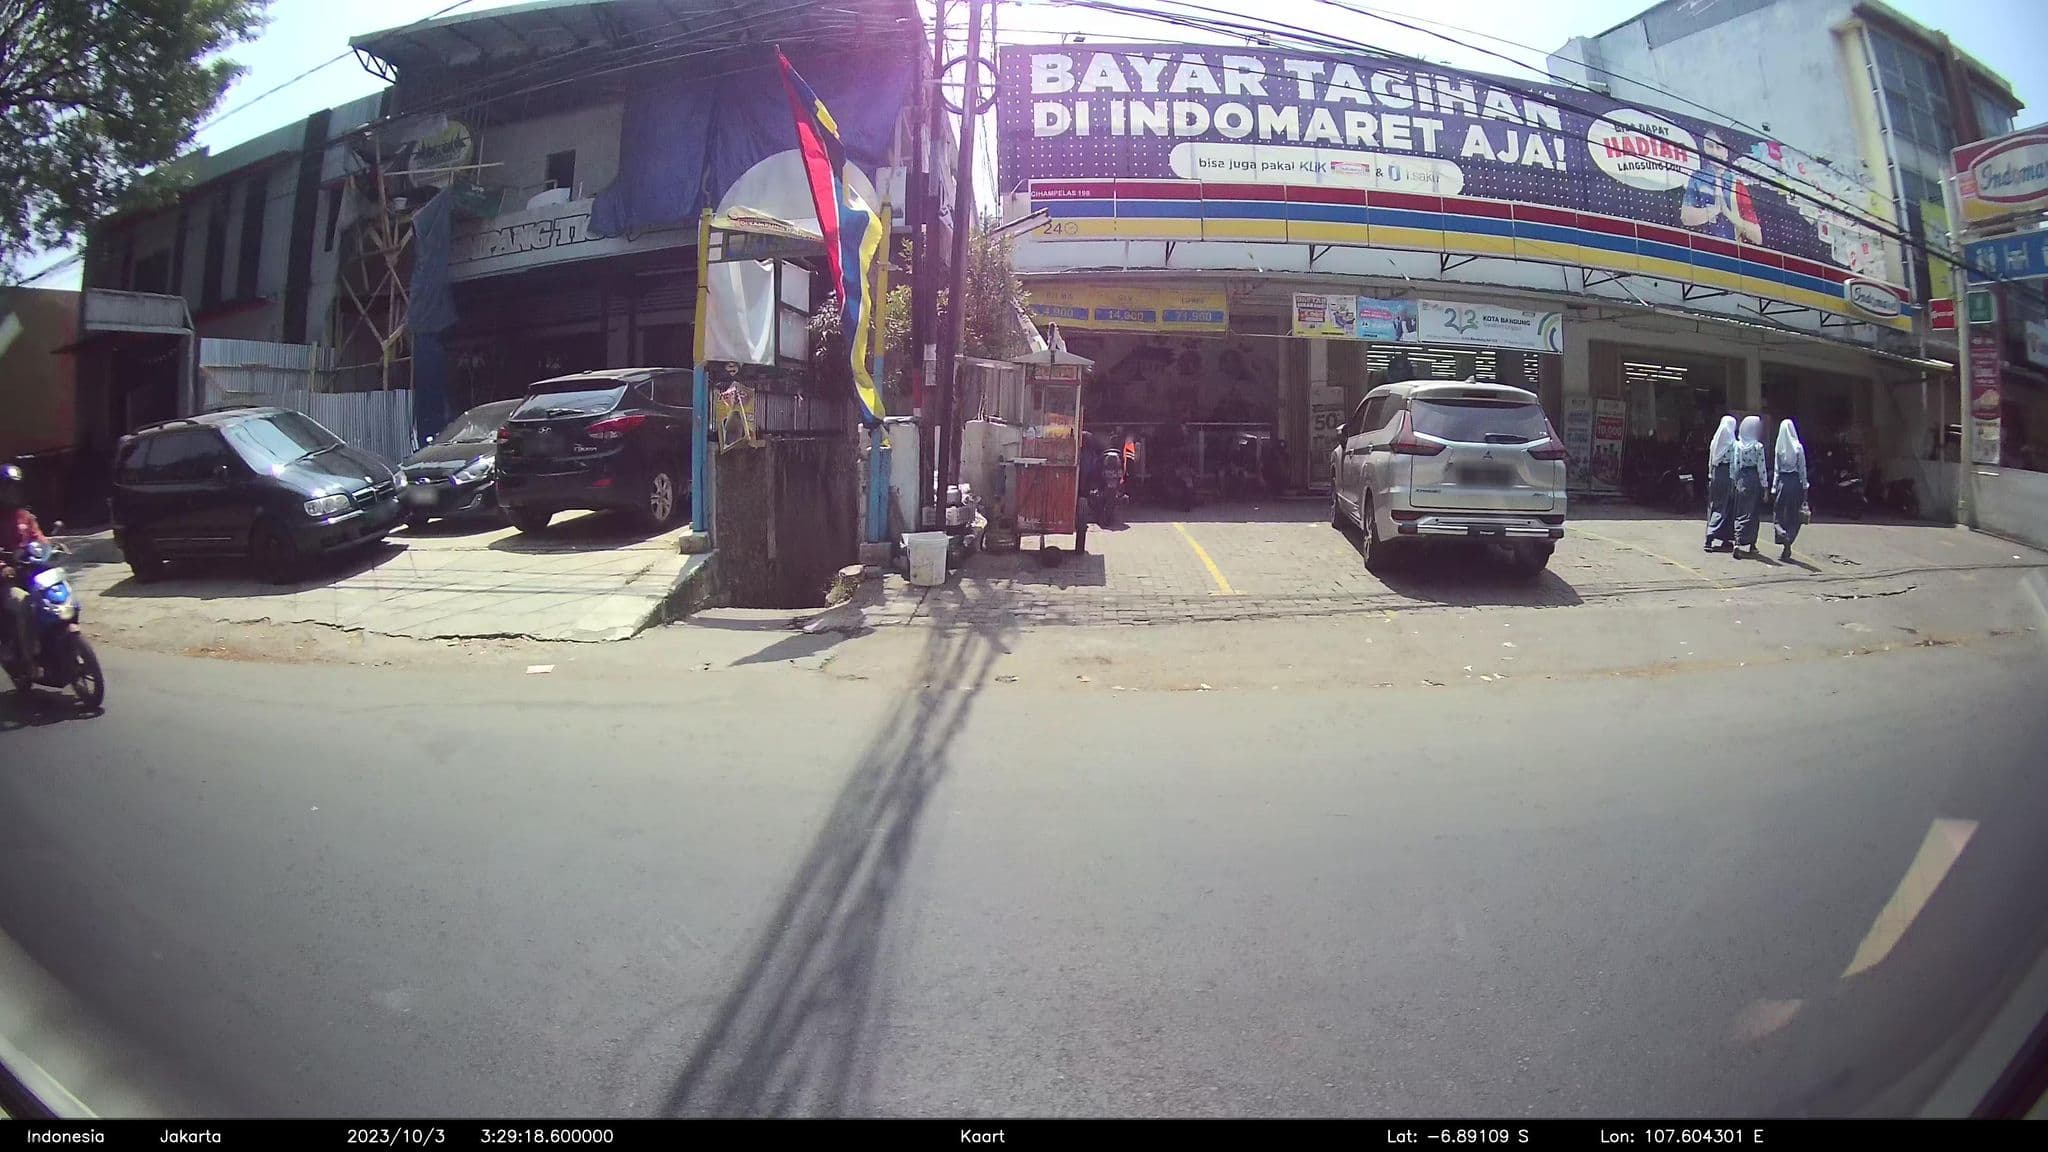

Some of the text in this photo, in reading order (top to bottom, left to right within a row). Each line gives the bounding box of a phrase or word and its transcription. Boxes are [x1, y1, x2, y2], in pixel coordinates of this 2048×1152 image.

[1031, 51, 1562, 131] BAYAR TAGIHAN
[1034, 101, 1567, 172] DI INDOMARET AJA!
[1639, 123, 1670, 136] DAPAT
[1603, 135, 1688, 162] HADIAH
[1199, 157, 1226, 169] bisa
[1229, 159, 1258, 171] juga
[1261, 160, 1295, 172] pakai
[1375, 167, 1384, 178] &
[1031, 189, 1077, 198] CIHAMPELAS
[1043, 222, 1063, 235] 24
